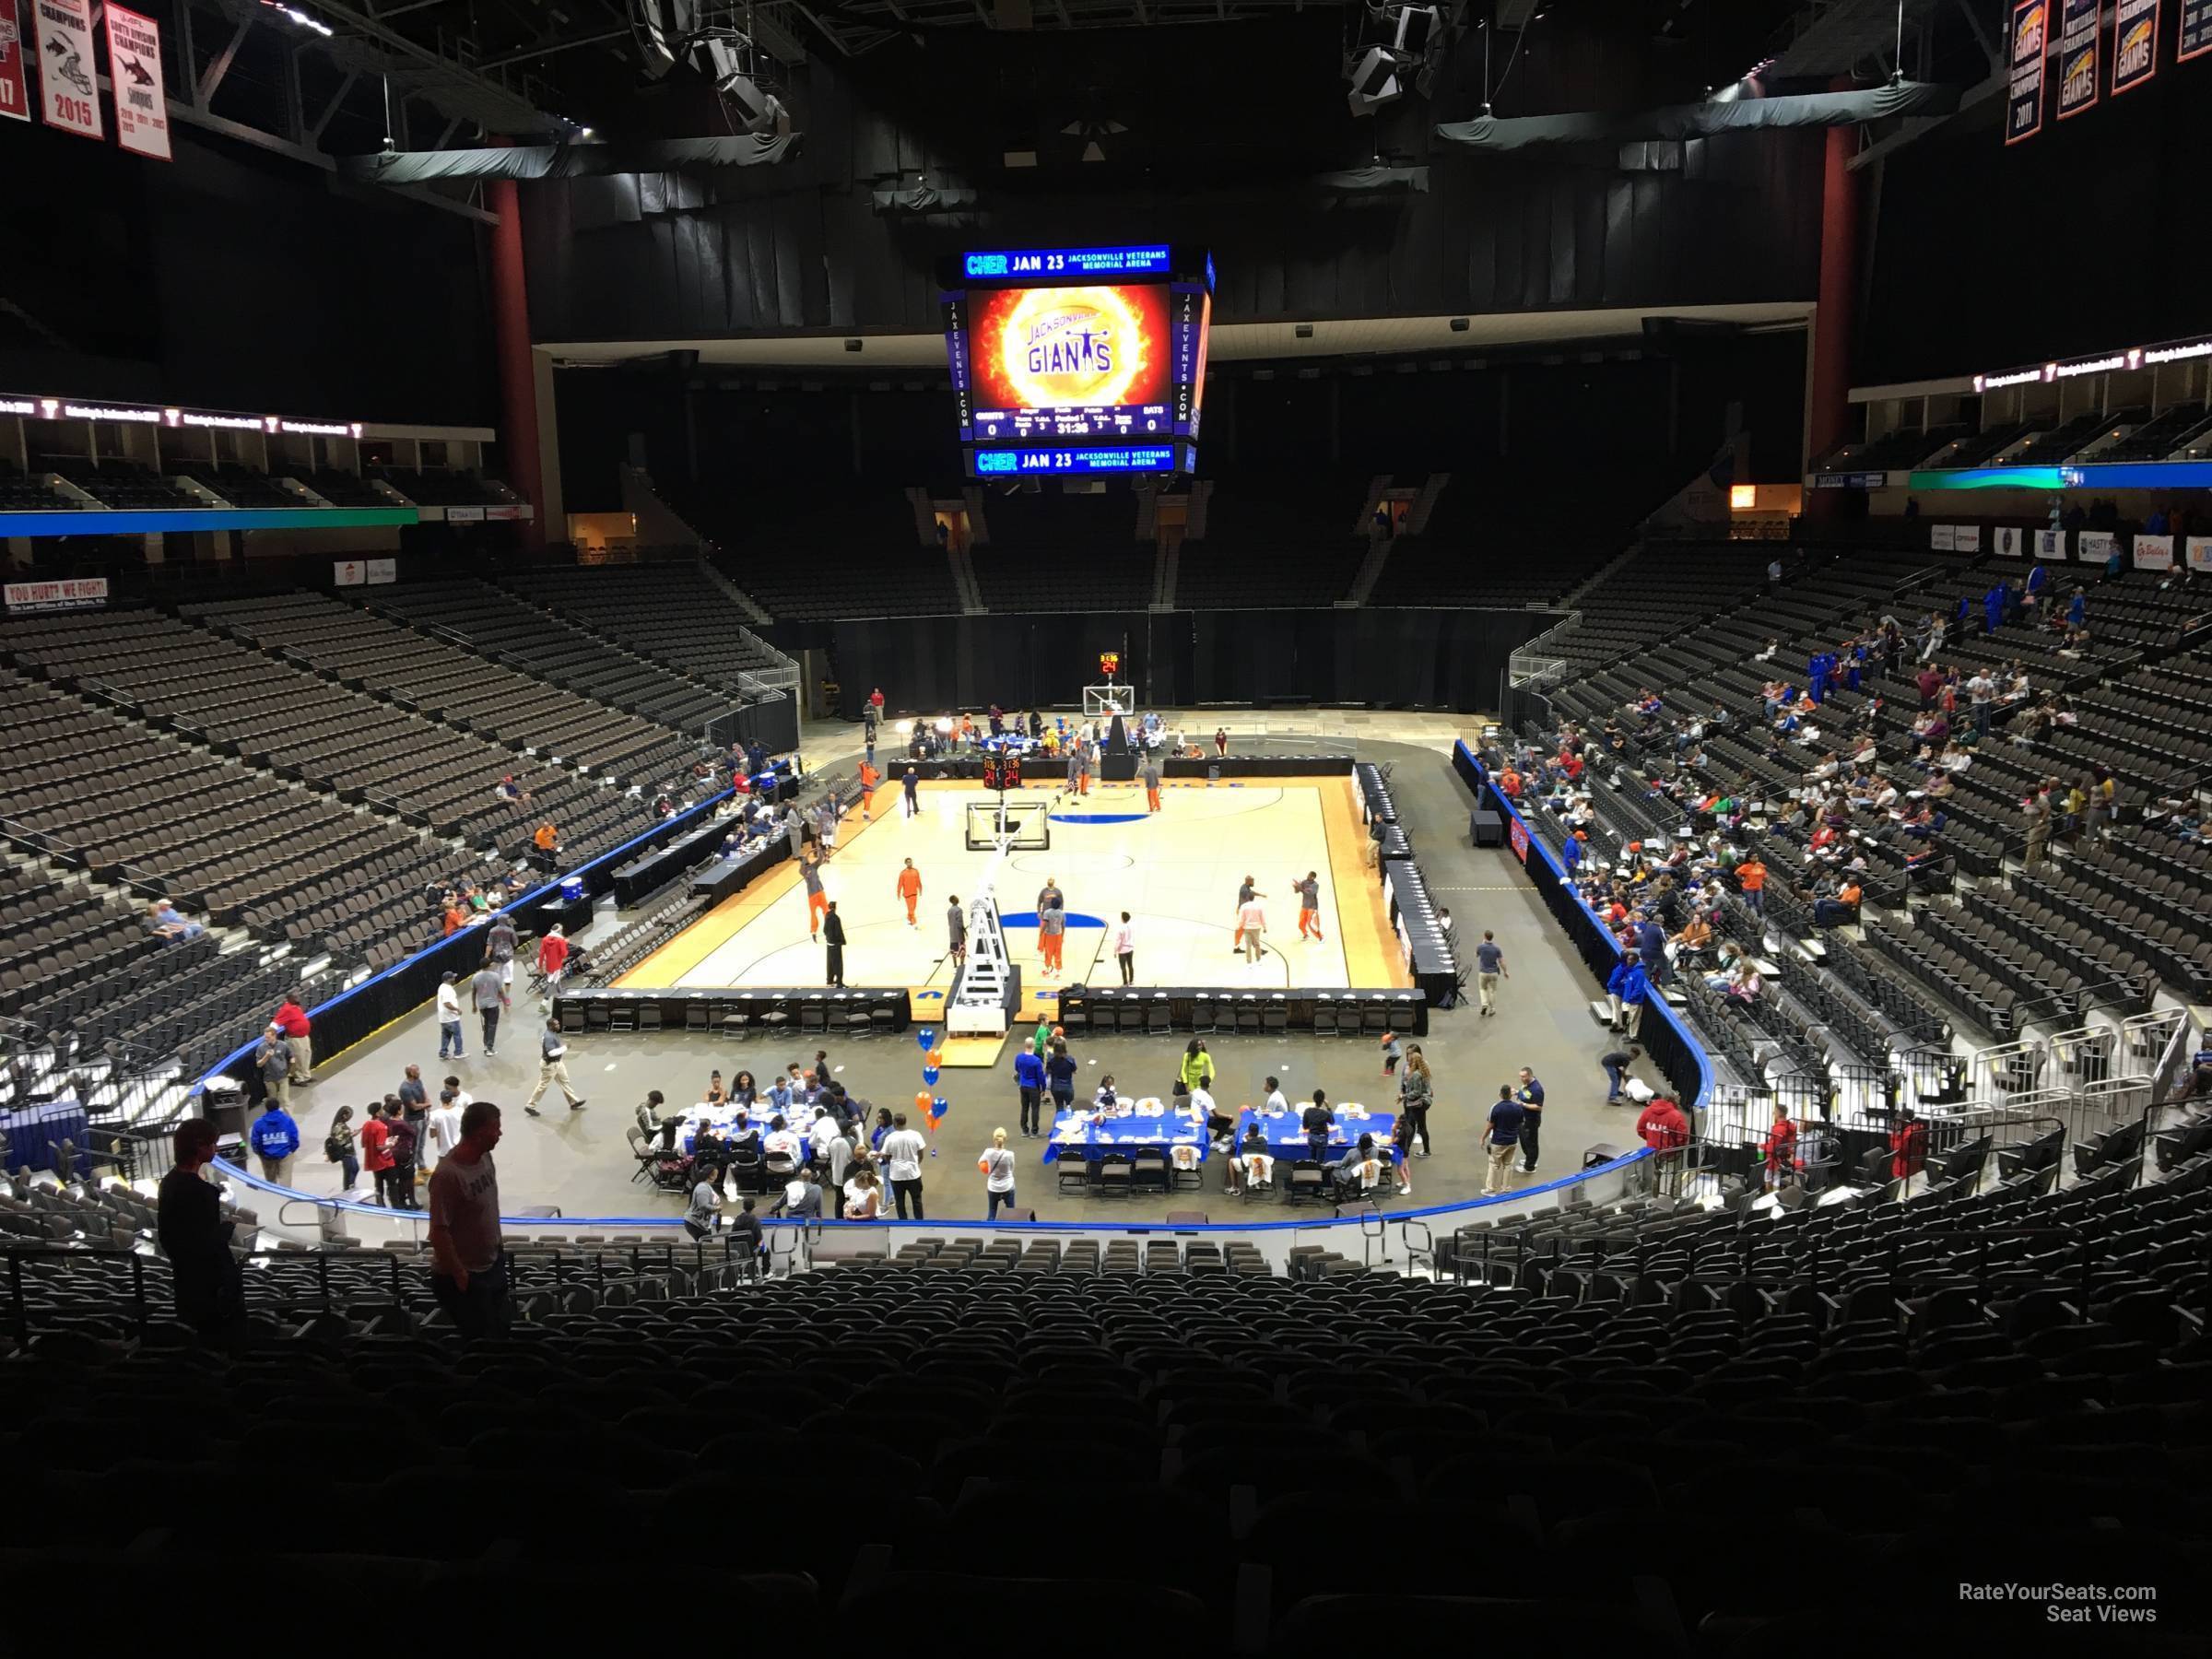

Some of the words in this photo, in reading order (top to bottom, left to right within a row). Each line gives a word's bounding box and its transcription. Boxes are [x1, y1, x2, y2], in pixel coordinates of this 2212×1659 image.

[41, 3, 87, 32] CHAMPIONS
[114, 33, 156, 59] CHAMPIONS
[2062, 69, 2094, 107] GIANTS
[54, 93, 92, 126] 2015
[2016, 101, 2033, 129] 2011
[967, 255, 1007, 275] CHER
[1013, 256, 1041, 271] JAN
[1047, 255, 1065, 270] 23
[1068, 253, 1124, 263] JACKSONVILLE
[1126, 251, 1166, 259] VETERANS
[1083, 260, 1123, 270] MEMORIAL
[1029, 333, 1111, 372] GIANTS
[988, 425, 996, 435] 0
[1147, 420, 1156, 430] 0
[978, 453, 1018, 471] CHER
[1022, 454, 1050, 468] JAN
[1055, 453, 1071, 467] 23
[1076, 452, 1130, 461] JACKSONVILLE
[1089, 459, 1129, 467] MEMORIAL
[9, 585, 29, 602] YOU
[30, 583, 60, 600] HURT?
[63, 582, 76, 597] WE
[77, 581, 104, 596] FIGHT!
[1102, 662, 1115, 672] 24
[1005, 770, 1018, 787] 24
